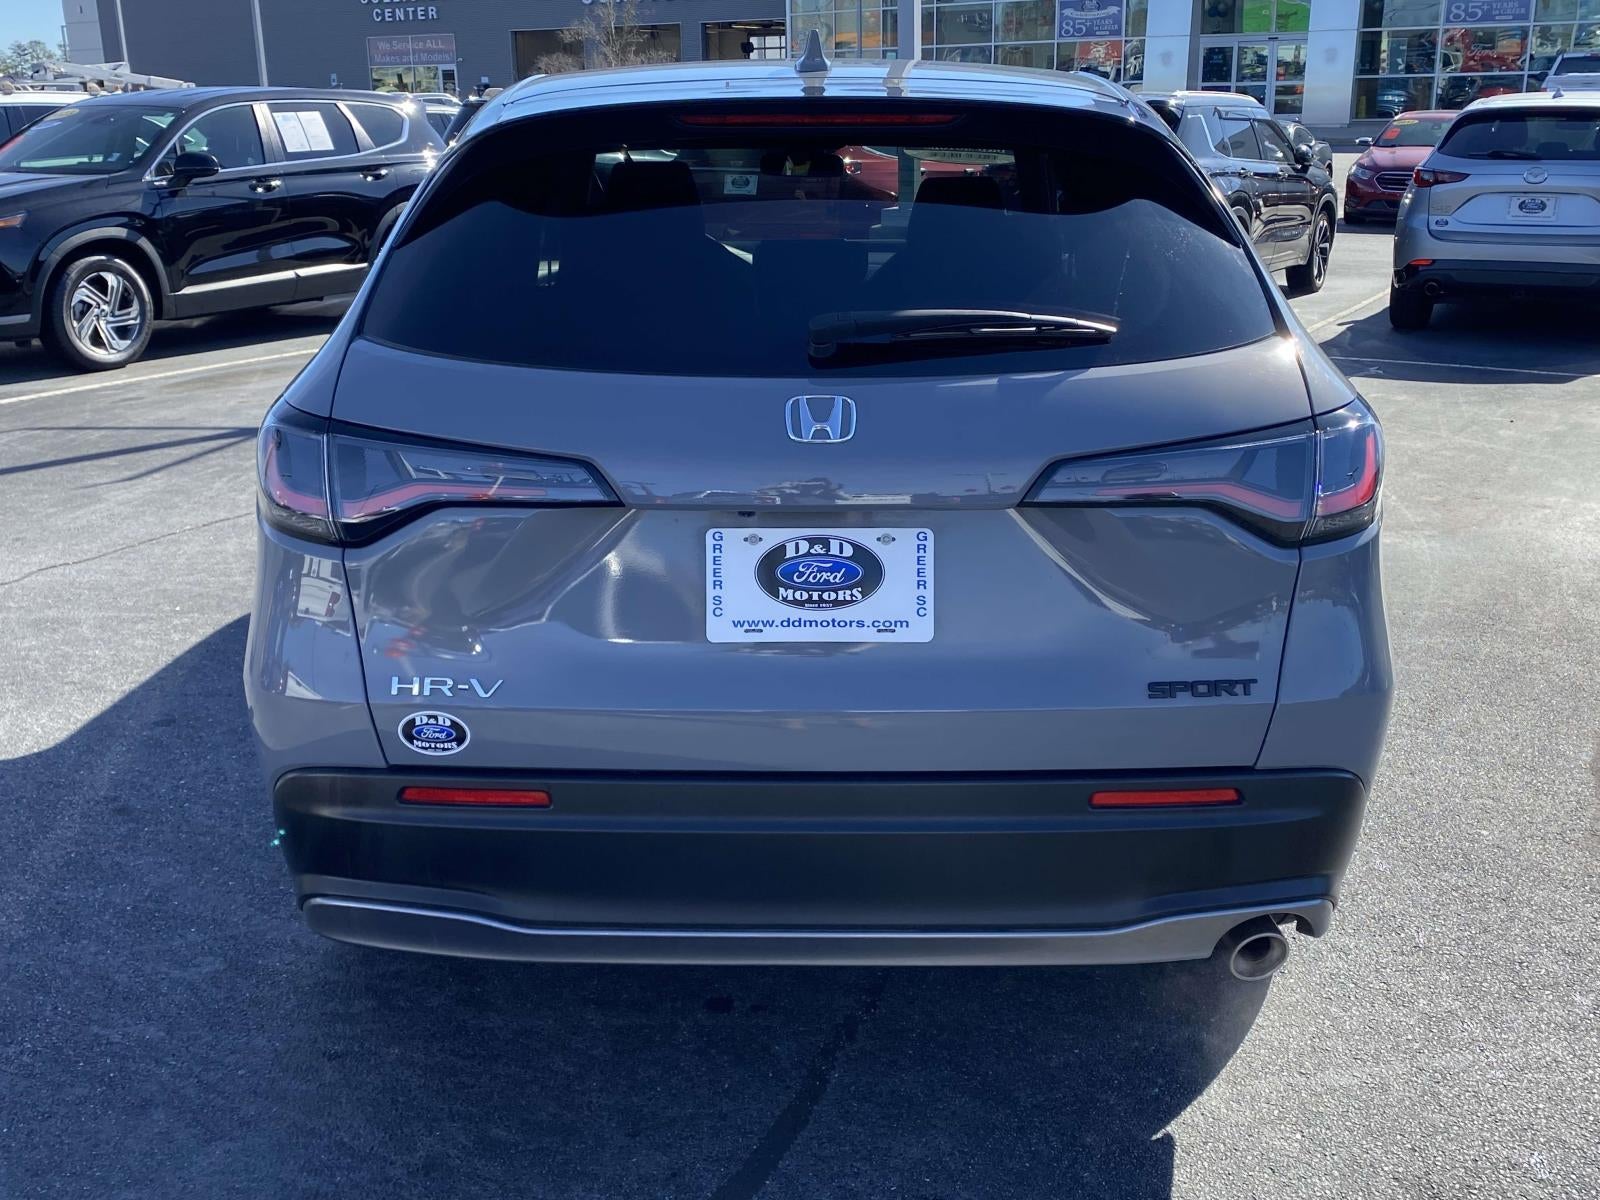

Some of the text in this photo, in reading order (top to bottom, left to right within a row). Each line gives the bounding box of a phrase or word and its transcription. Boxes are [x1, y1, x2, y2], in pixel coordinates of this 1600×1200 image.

[373, 6, 438, 22] CENTER
[377, 41, 391, 50] We
[425, 39, 445, 49] ALL
[374, 54, 400, 63] Makes
[783, 538, 854, 559] D&D
[711, 530, 724, 618] GREER SC
[793, 561, 846, 584] Ford
[915, 530, 928, 618] GREER SC
[778, 586, 863, 601] MOTORS
[731, 617, 910, 629] www.ddmotors.com
[390, 676, 504, 698] HR-V
[1147, 678, 1259, 699] SPORT
[414, 715, 452, 727] D&D
[420, 727, 447, 740] Ford
[413, 739, 458, 749] MOTORS
